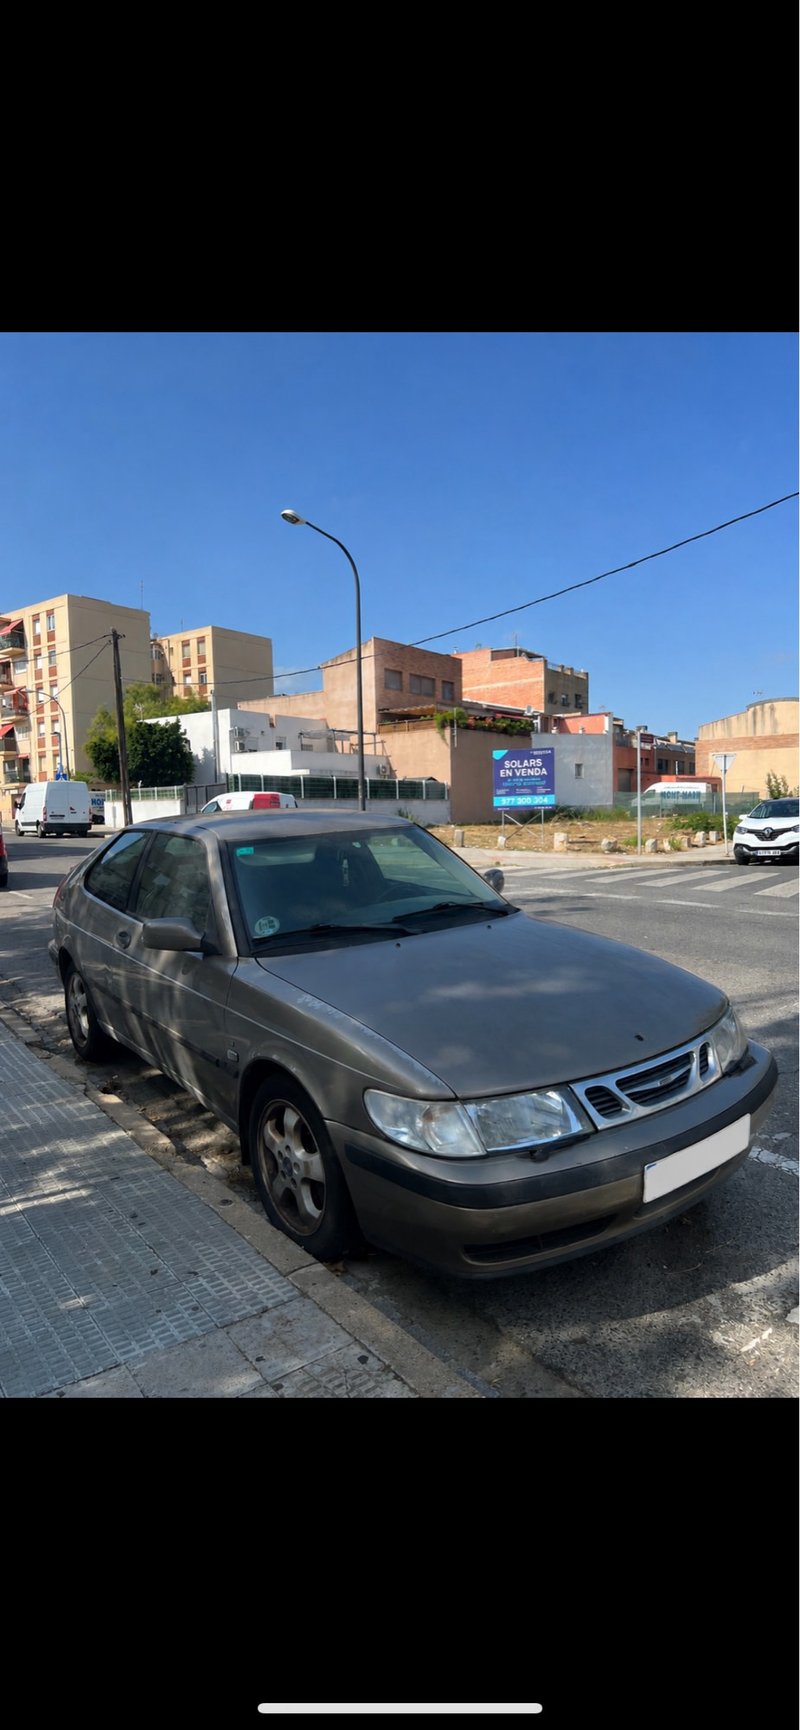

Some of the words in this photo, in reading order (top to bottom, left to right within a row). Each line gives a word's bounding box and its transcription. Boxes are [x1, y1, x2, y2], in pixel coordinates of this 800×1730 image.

[504, 758, 543, 769] SOLARS
[500, 769, 513, 778] EN
[514, 767, 548, 777] VENDA
